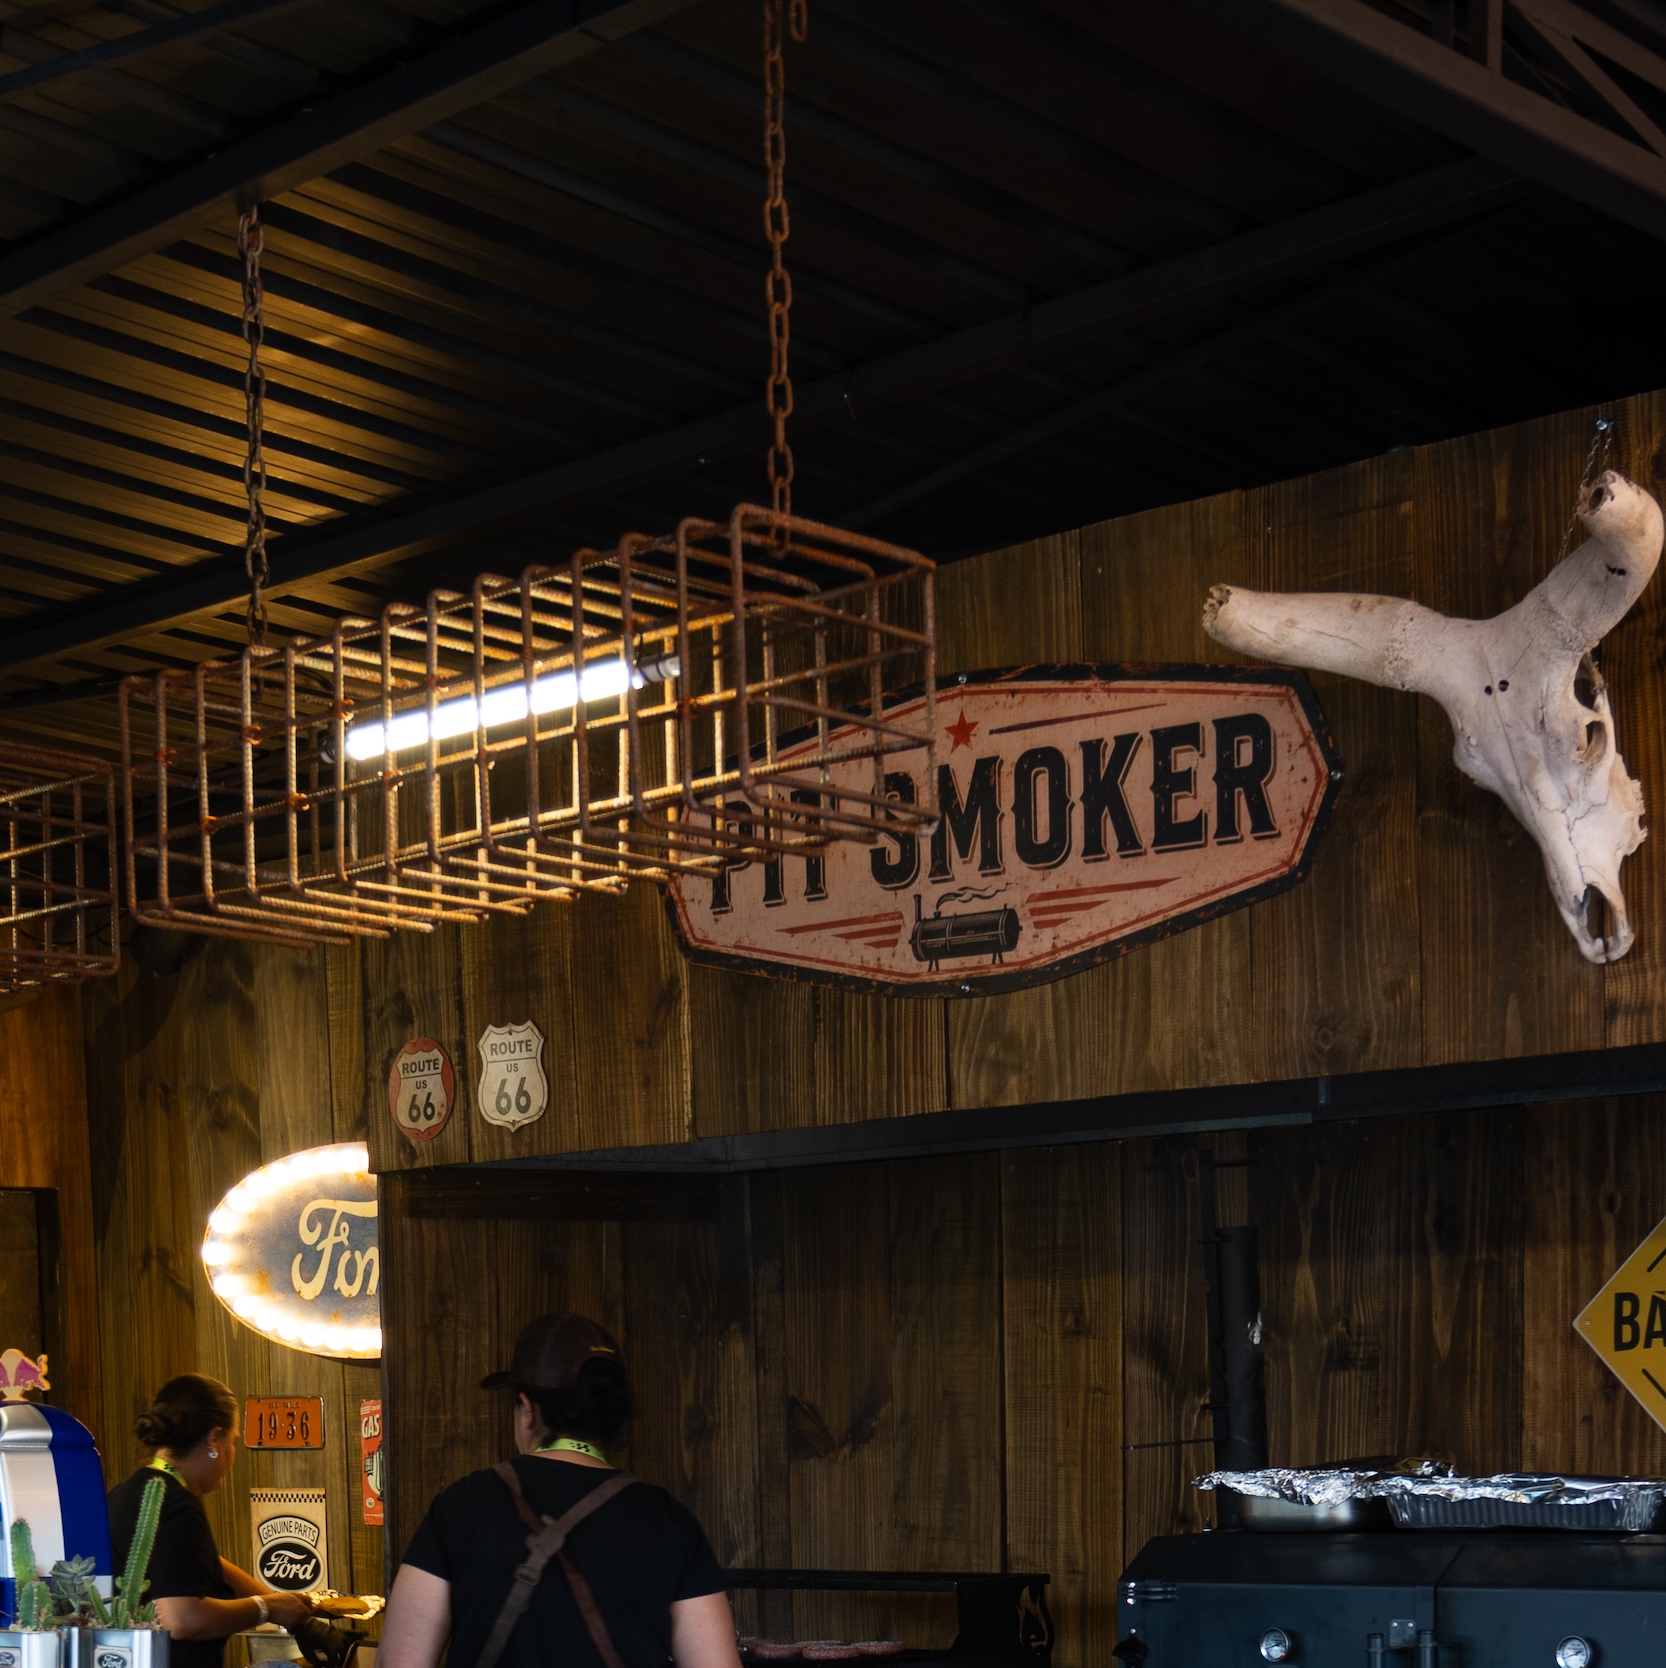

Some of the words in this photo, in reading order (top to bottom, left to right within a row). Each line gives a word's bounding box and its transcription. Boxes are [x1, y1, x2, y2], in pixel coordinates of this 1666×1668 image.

[869, 712, 1281, 891] SMOKER
[489, 1039, 533, 1056] ROUTE
[402, 1058, 440, 1075] ROUTE
[506, 1063, 519, 1072] US
[415, 1079, 428, 1089] US
[495, 1076, 532, 1115] 66
[408, 1092, 436, 1123] 66
[291, 1199, 380, 1301] For
[362, 1413, 381, 1439] GAS
[261, 1520, 293, 1540] GENUINE
[294, 1521, 317, 1542] PARTS
[263, 1550, 317, 1580] Ford
[101, 1654, 123, 1668] Ford
